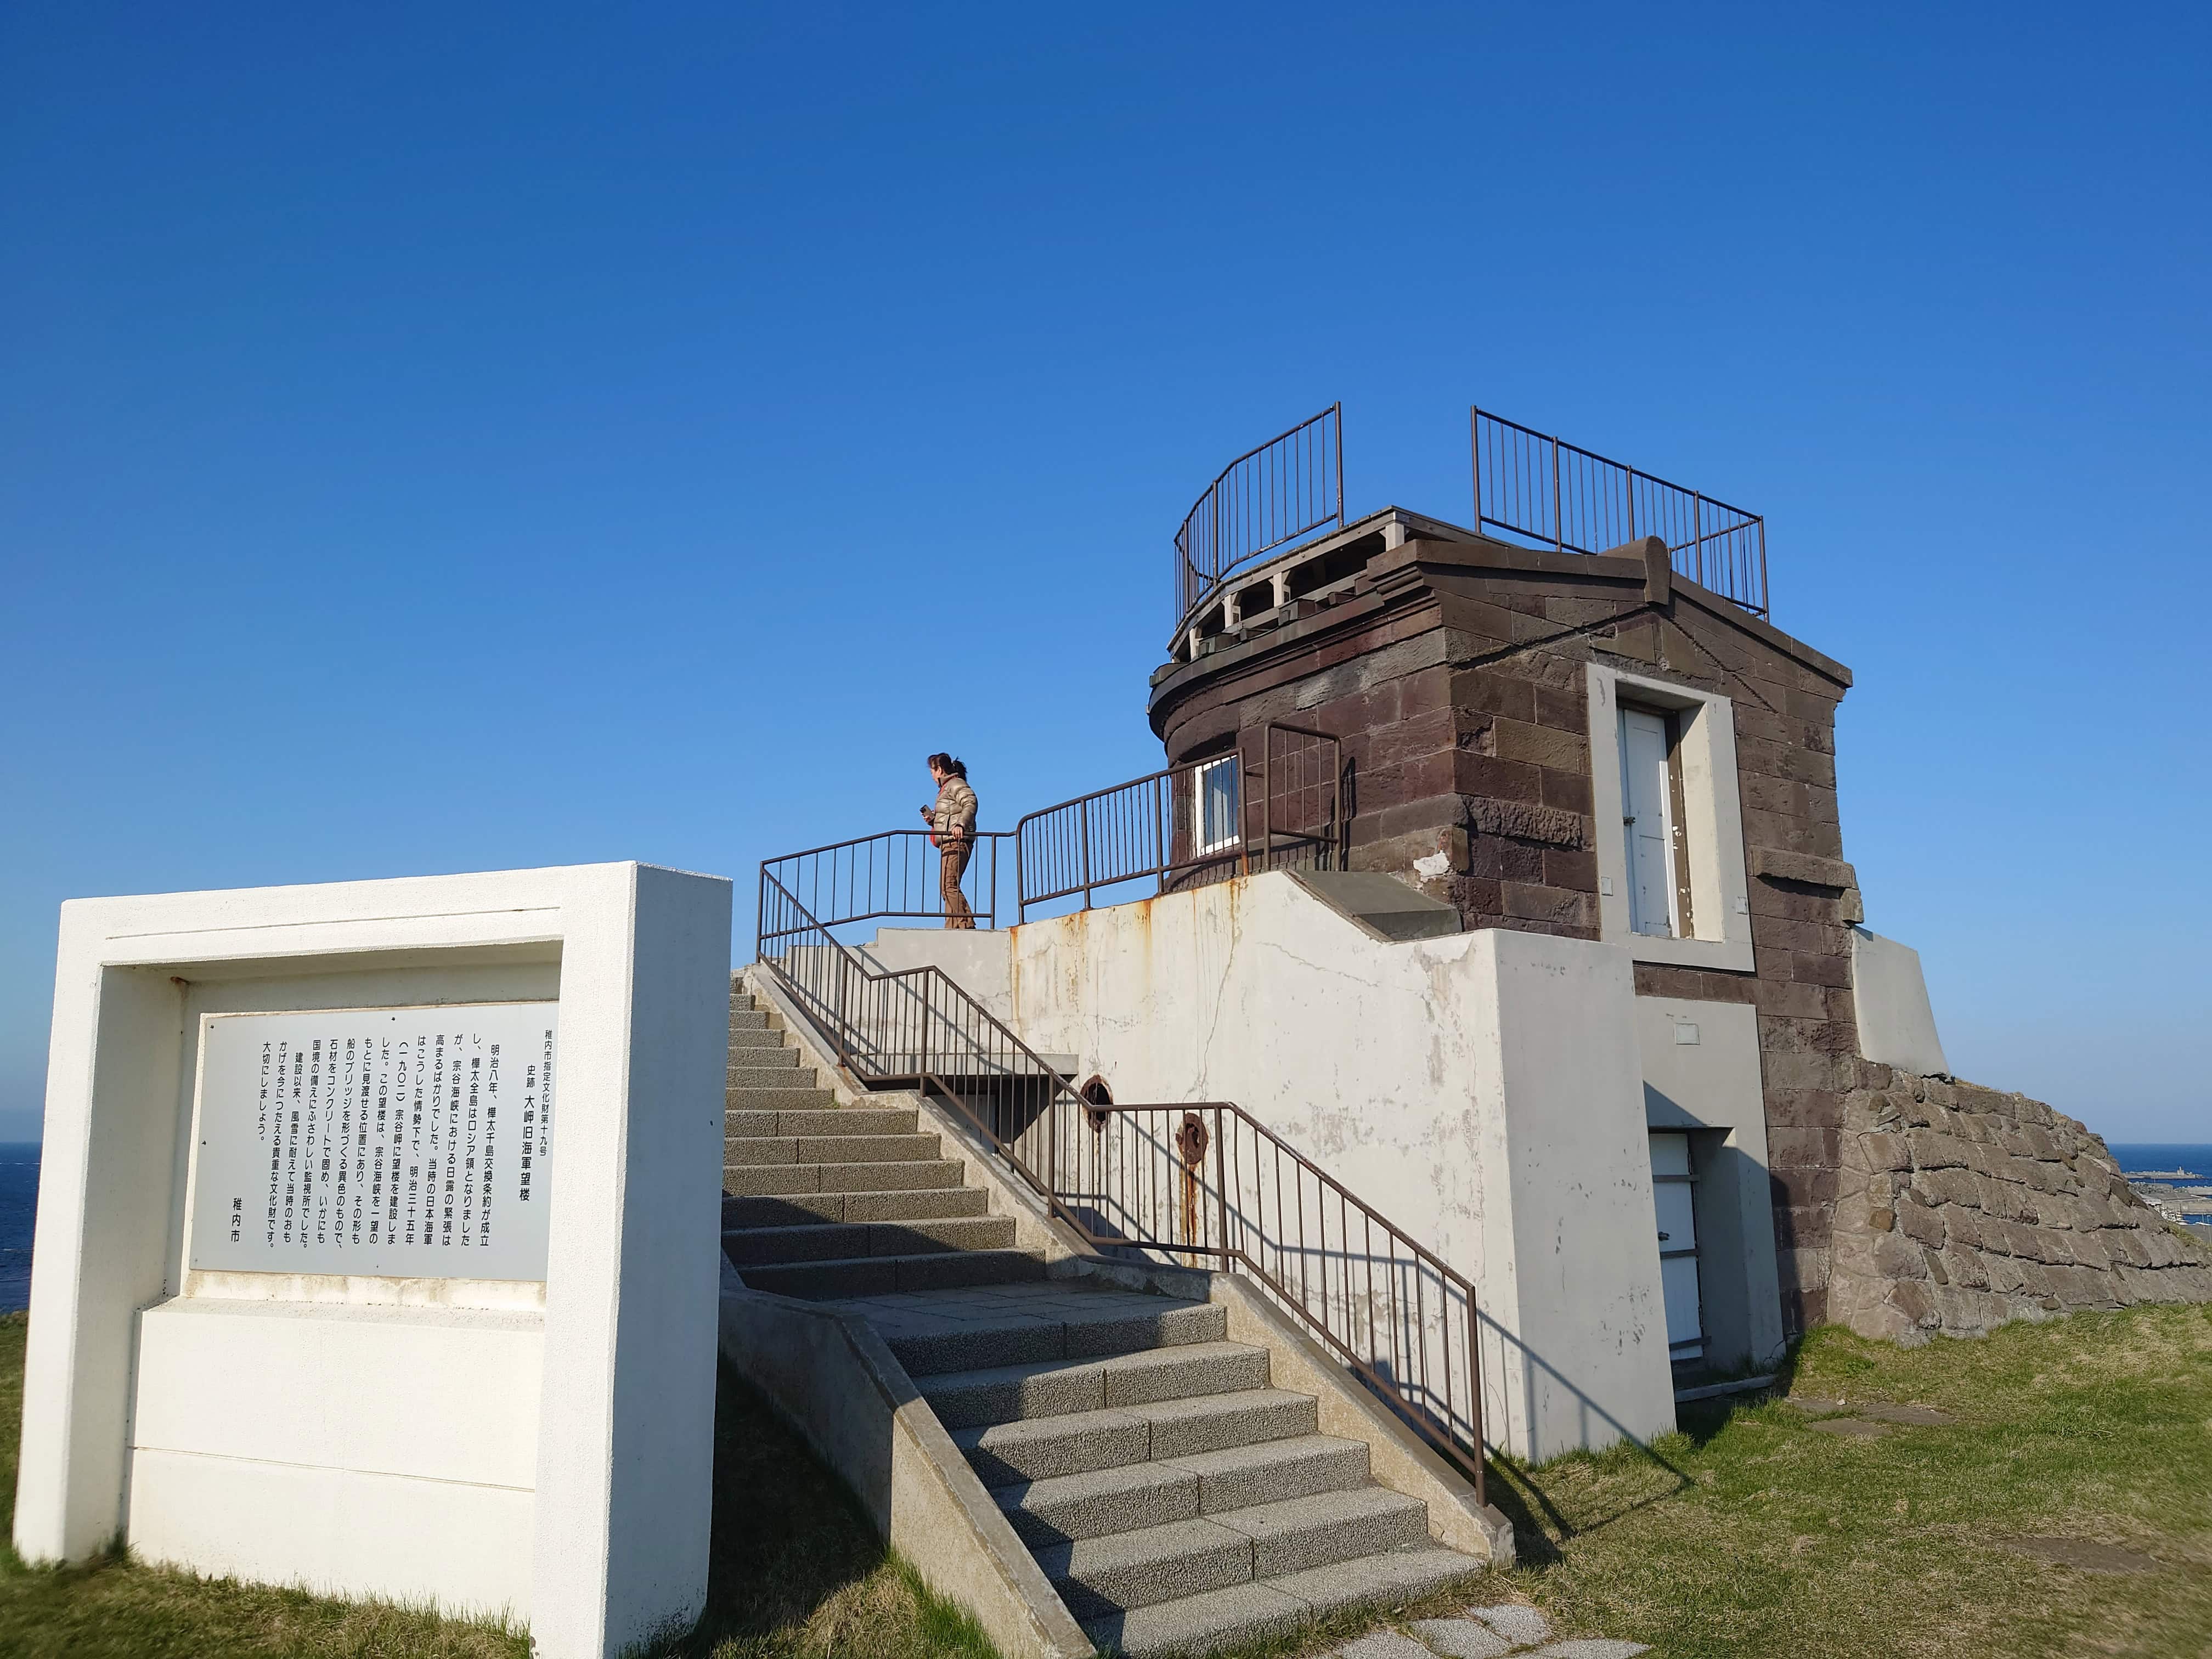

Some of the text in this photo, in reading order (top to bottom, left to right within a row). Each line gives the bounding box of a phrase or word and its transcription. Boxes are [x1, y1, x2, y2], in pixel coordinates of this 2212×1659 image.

[257, 1041, 272, 1141] 大切にしましょう。
[267, 1041, 287, 1248] かげを今につたえる貴重な文化財です。
[283, 1052, 303, 1243] 建設以来、風雪に耐えて当時のおも
[300, 1040, 321, 1248] 国境の備えにふさわしい監視所でした。
[317, 1039, 338, 1244] 石材をコンクリートで固め、いかにも
[334, 1038, 356, 1249] 船のブリッジを形づくる異色のもので、
[352, 1037, 373, 1244] もとに見渡せる位置にあり、その形も
[369, 1036, 390, 1244] した。この望楼は、宗谷海峡を一望の
[405, 1035, 426, 1245] はこうした情勢下で、明治三十五年
[423, 1034, 445, 1246] 高まるばかりでした。当時の日本海軍
[442, 1034, 464, 1246] が、宗谷海峡における日露の緊張は
[461, 1033, 481, 1246] し、樺太全島はロシア領となりました
[479, 1044, 500, 1246] 明治八年、樺太千島交換条約が成立
[539, 1029, 553, 1156] 稚内市指定文化財第十九号
[230, 1197, 242, 1243] 稚内市
